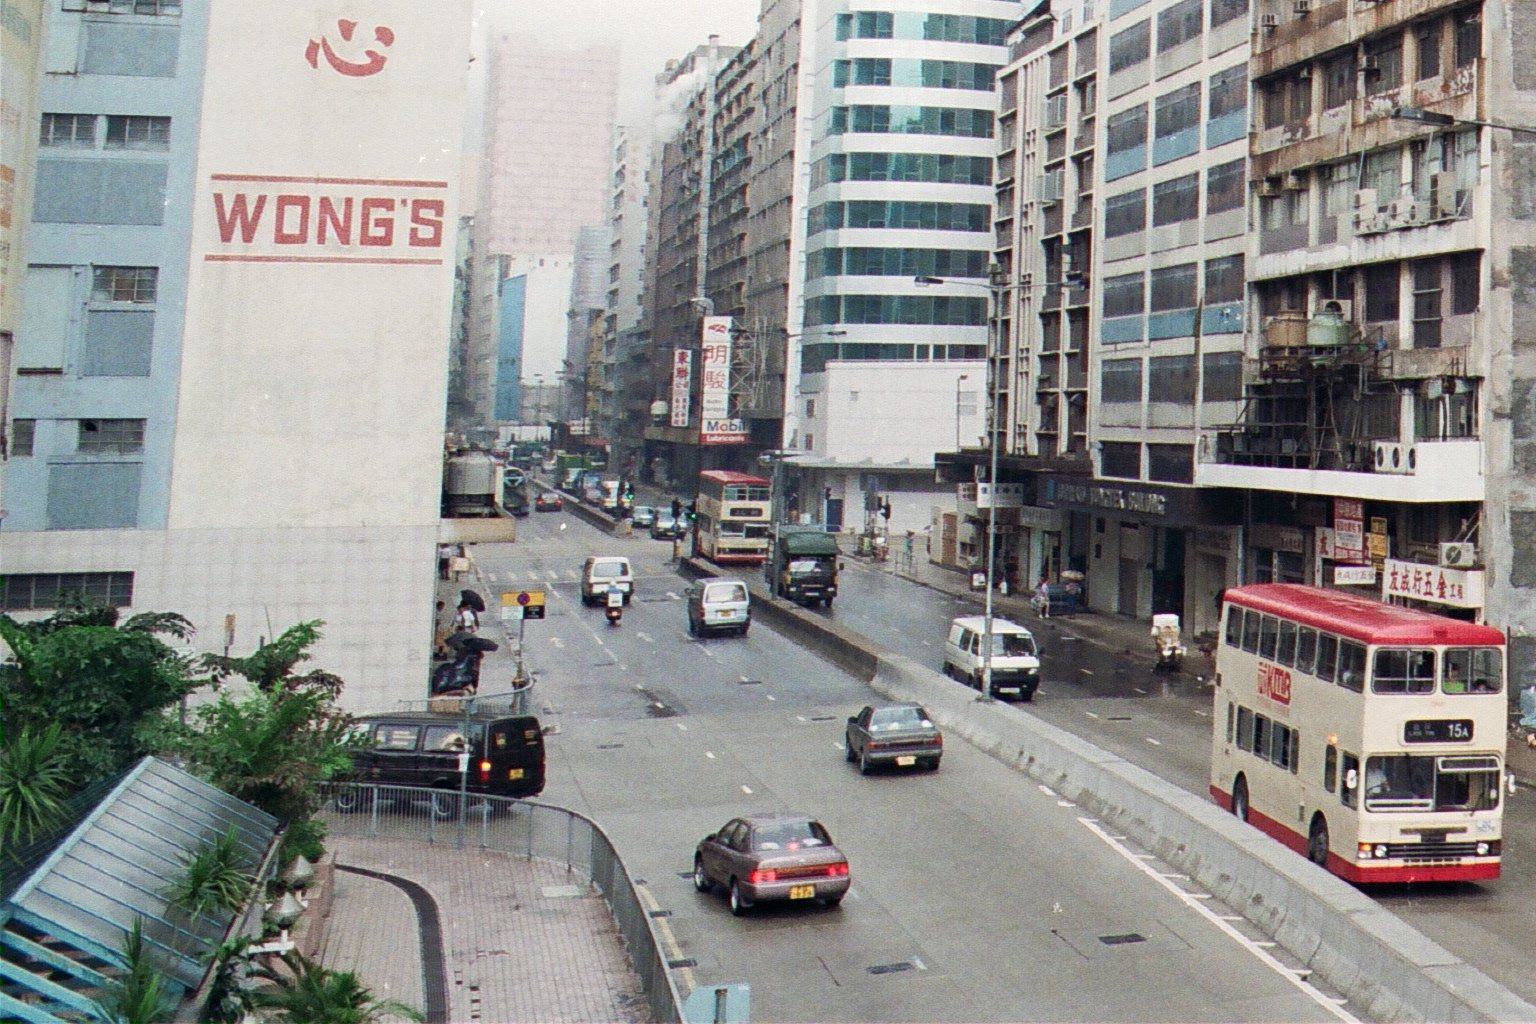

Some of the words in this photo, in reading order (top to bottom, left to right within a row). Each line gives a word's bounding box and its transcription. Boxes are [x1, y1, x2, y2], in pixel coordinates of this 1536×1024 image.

[213, 192, 445, 248] WONG'S
[706, 419, 745, 432] Mobil
[1448, 723, 1469, 738] 15A
